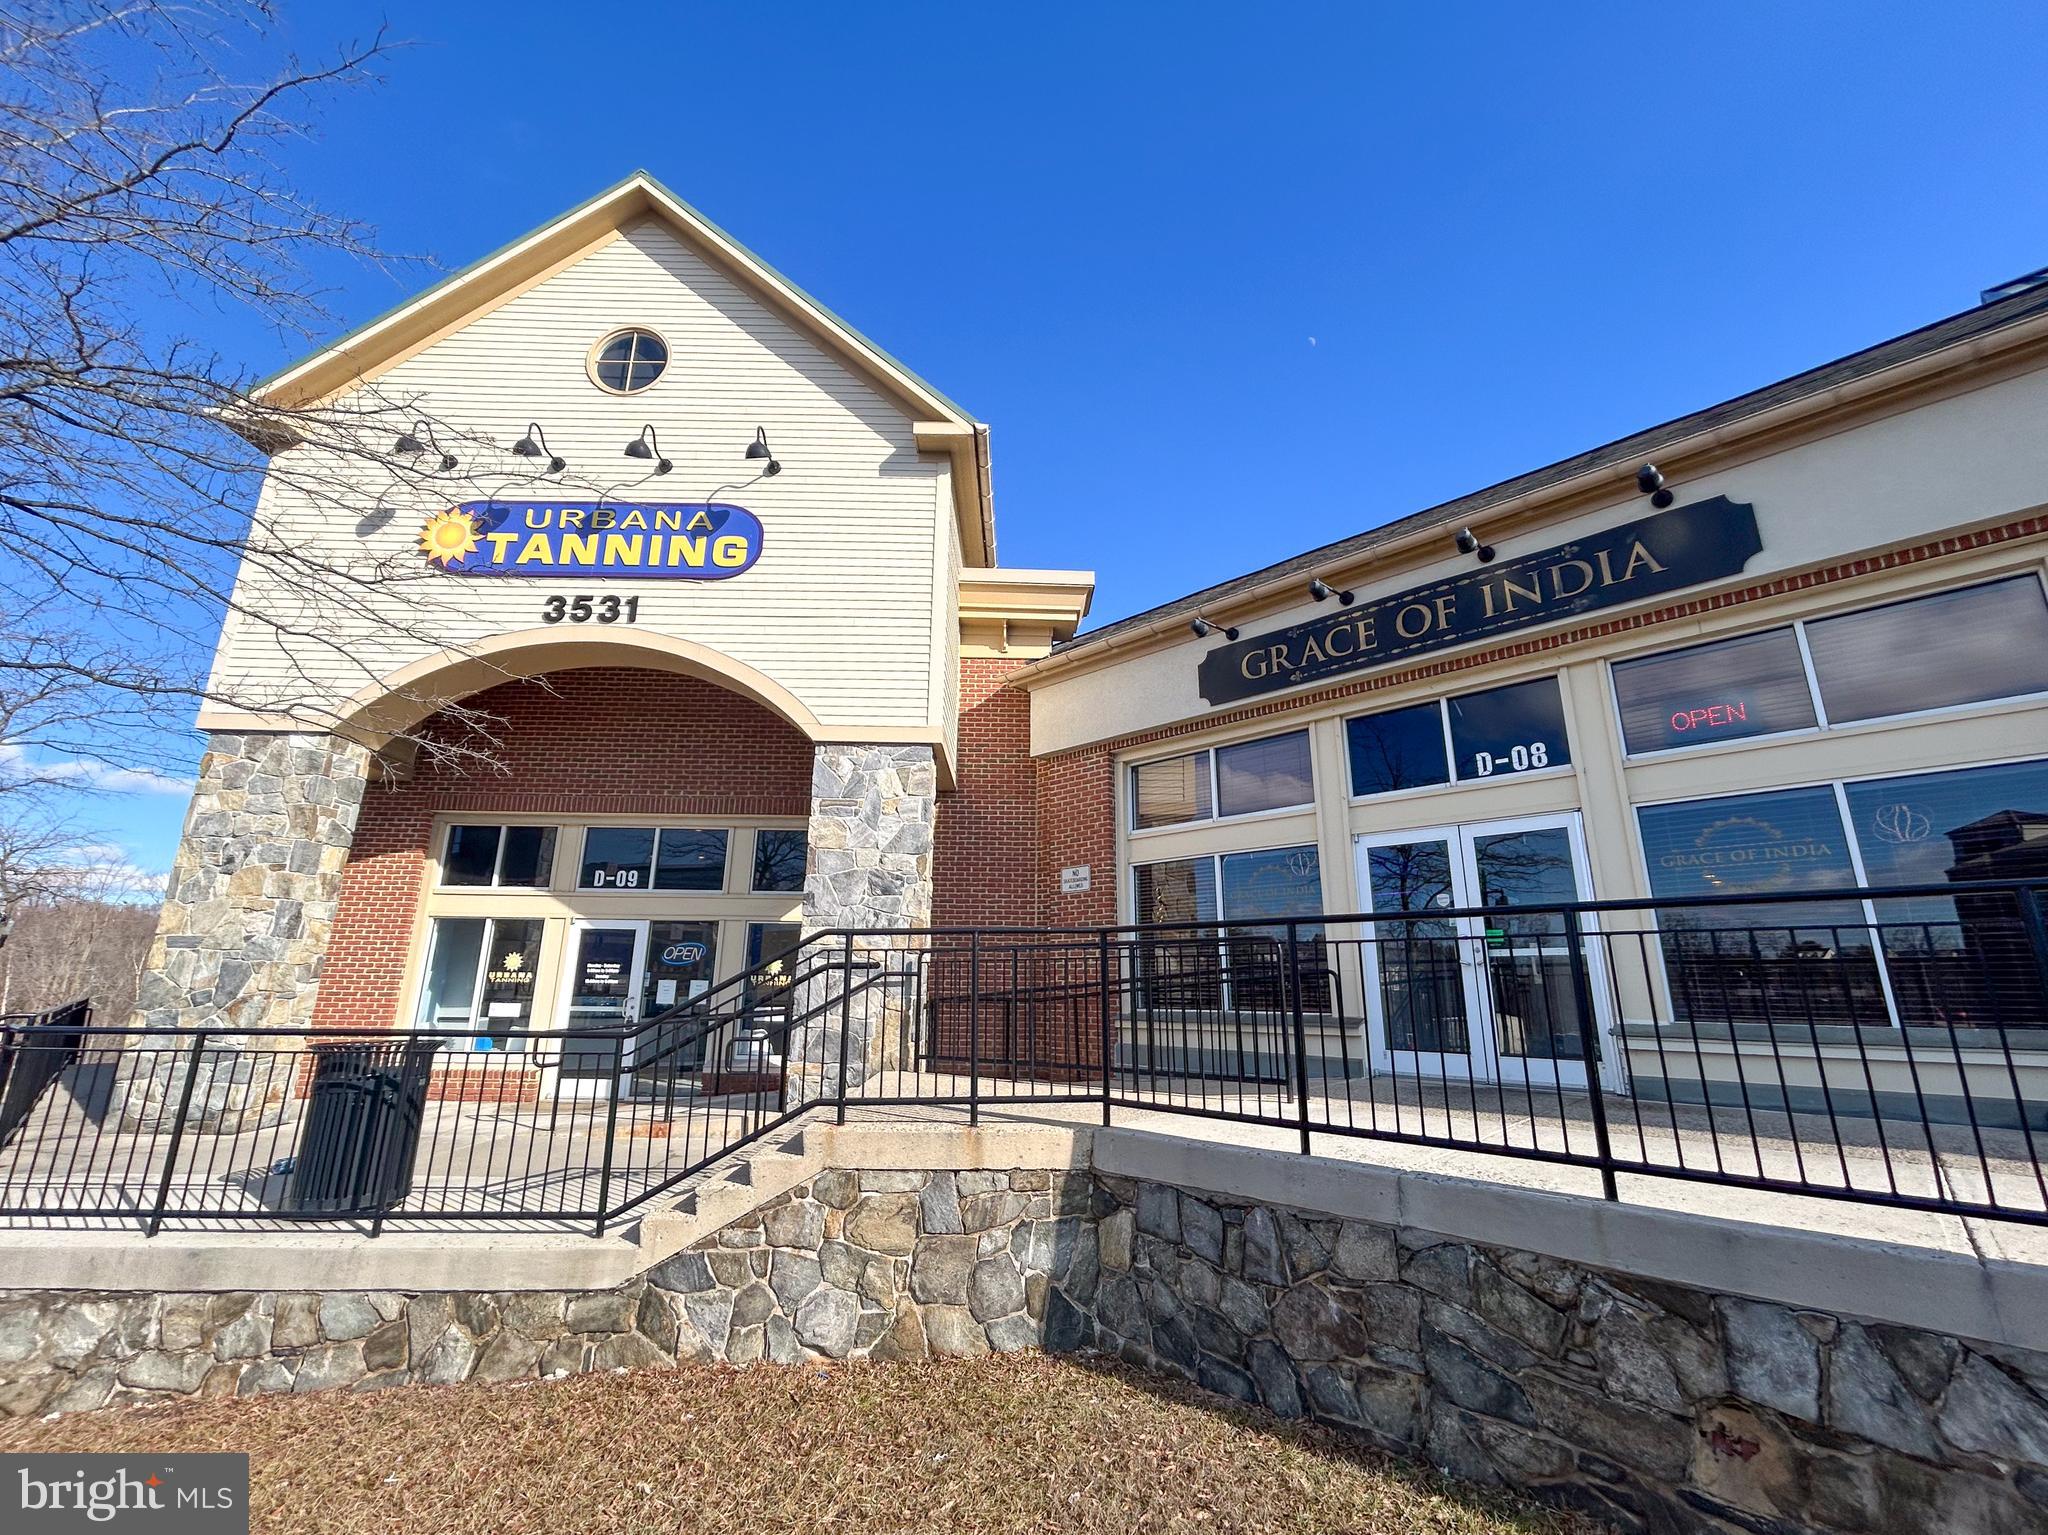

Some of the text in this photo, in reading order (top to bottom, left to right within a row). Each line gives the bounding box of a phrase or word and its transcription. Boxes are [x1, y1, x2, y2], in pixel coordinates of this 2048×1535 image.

[525, 508, 714, 531] URBANA
[486, 532, 749, 568] TANNING
[541, 595, 640, 625] 3531
[1240, 540, 1669, 680] GRACE OF INDIA
[1671, 702, 1748, 732] OPEN
[1475, 742, 1548, 776] D-08
[1660, 843, 1832, 868] GRACE OF INDIA
[593, 870, 638, 887] D-09
[663, 946, 704, 961] OPEN
[488, 971, 533, 979] URBANA
